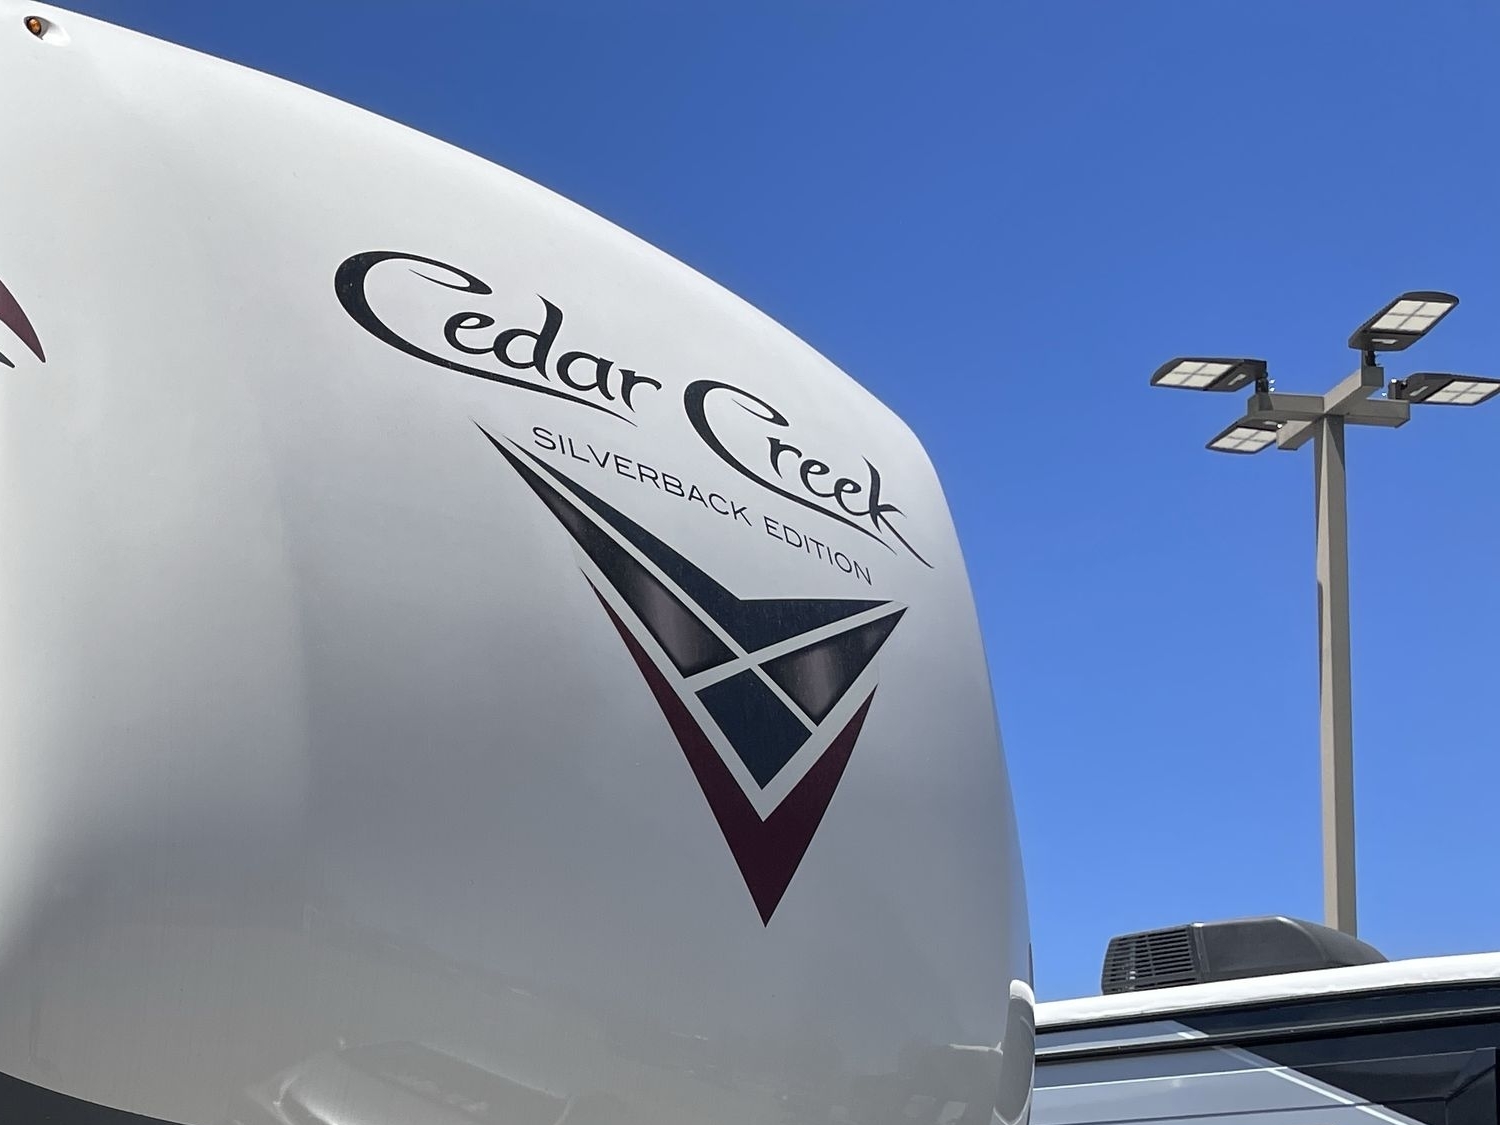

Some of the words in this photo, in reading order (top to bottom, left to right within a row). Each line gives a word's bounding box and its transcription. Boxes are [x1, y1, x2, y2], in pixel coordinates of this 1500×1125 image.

[334, 250, 662, 427] Cedar
[684, 379, 933, 569] Creek
[532, 426, 752, 526] SILVERBACK
[764, 516, 873, 586] EDITION
